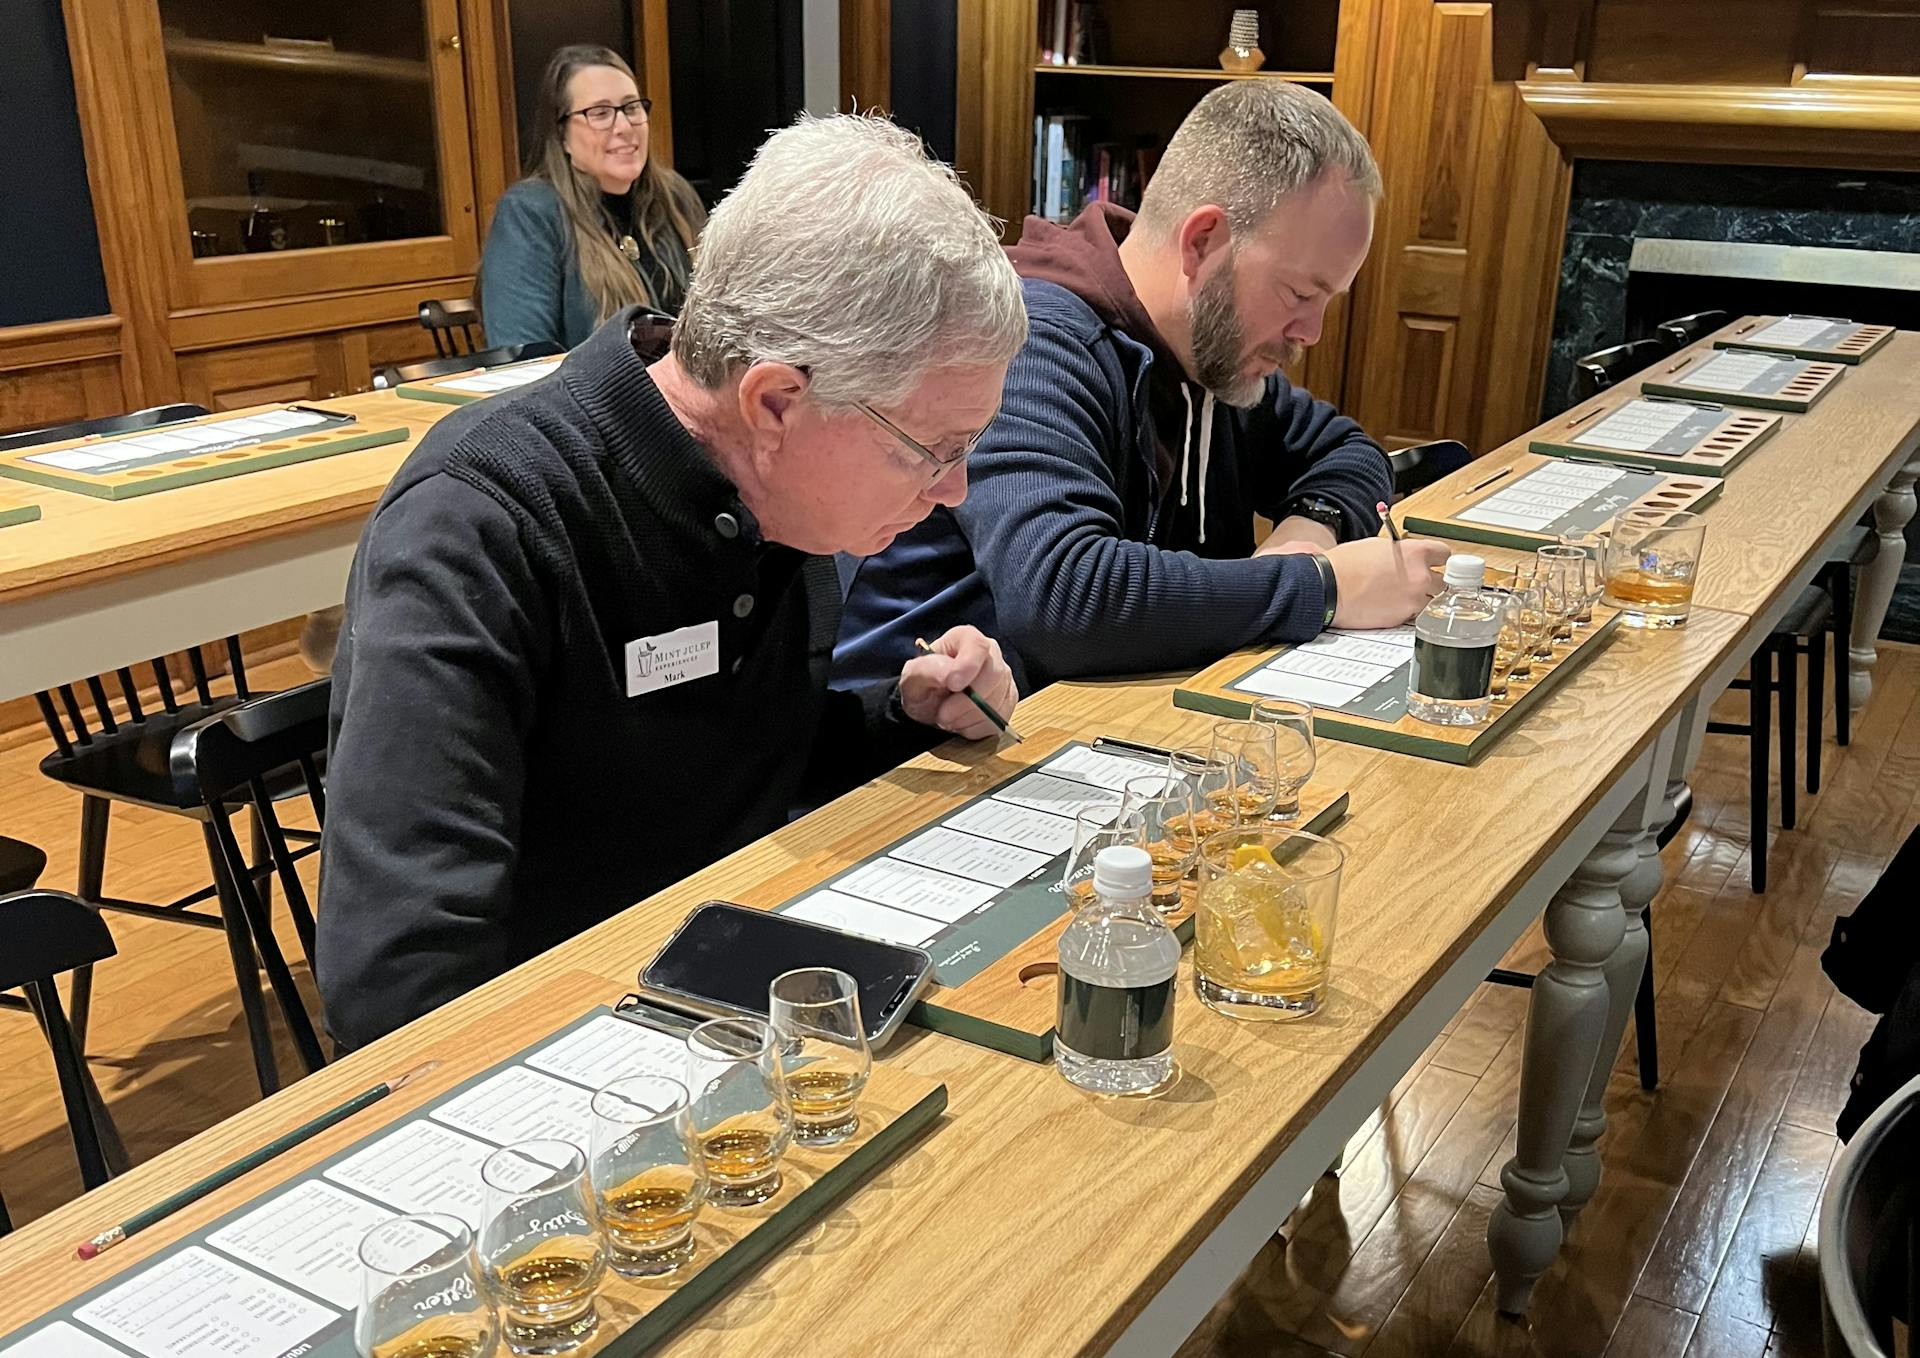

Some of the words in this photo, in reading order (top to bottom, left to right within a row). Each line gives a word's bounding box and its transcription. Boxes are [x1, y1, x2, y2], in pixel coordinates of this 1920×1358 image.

[655, 649, 681, 663] MINT
[683, 641, 711, 655] JULEP
[664, 669, 686, 683] Mark
